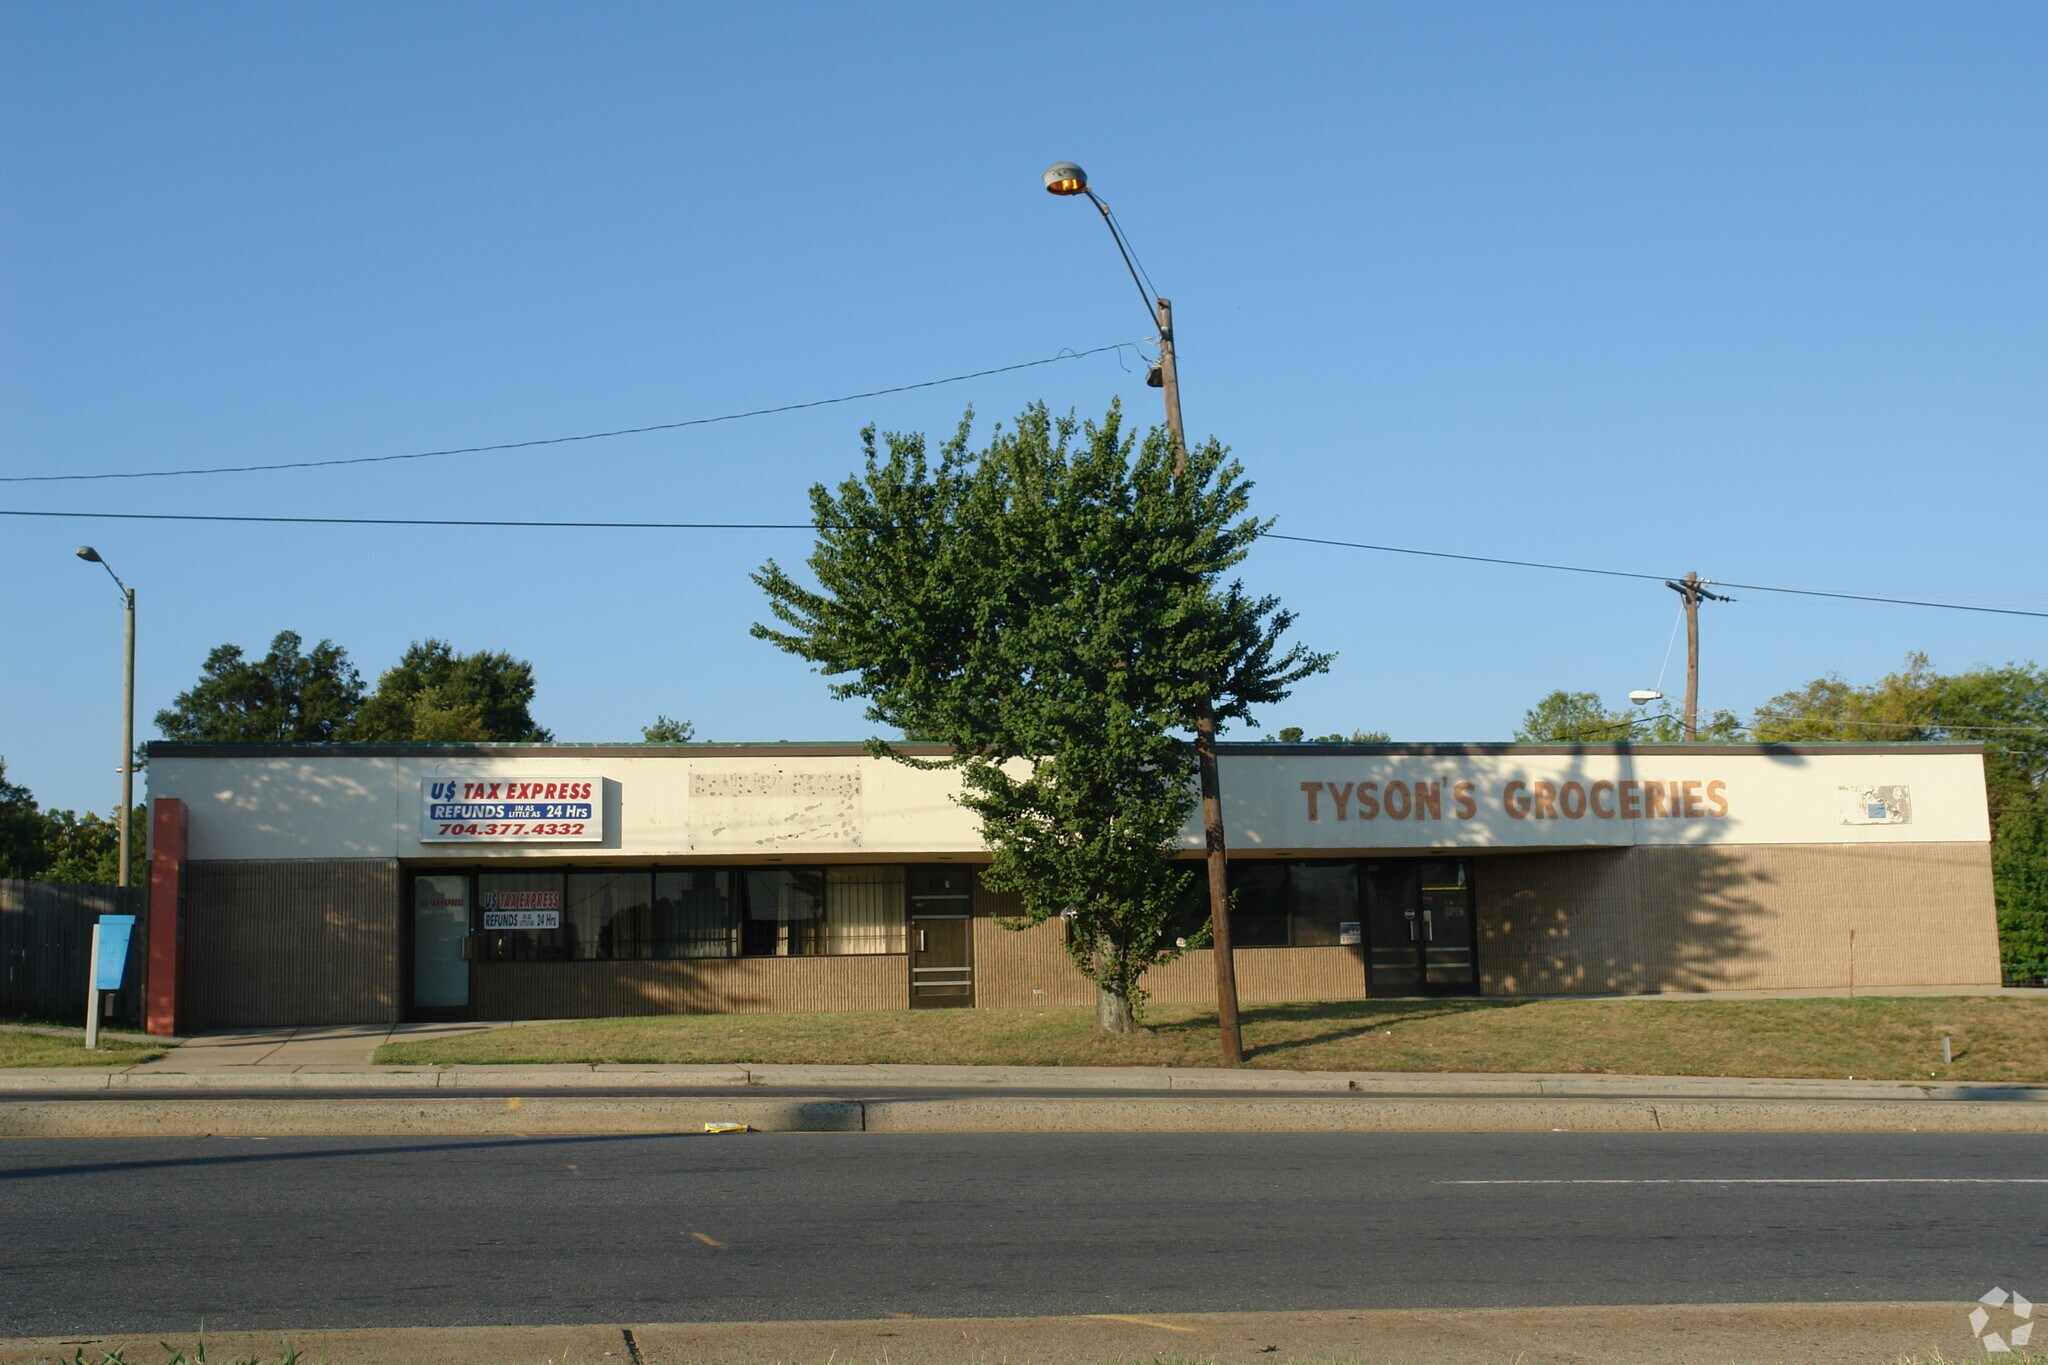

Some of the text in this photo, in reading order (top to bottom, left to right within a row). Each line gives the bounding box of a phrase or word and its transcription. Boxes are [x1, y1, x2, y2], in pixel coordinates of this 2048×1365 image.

[430, 780, 592, 802] U$ TAX EXPRESS
[1300, 776, 1729, 821] TYSON'S GROCERIES
[434, 805, 505, 819] REFUNDS
[546, 805, 588, 818] 24 Hrs
[438, 823, 586, 836] 704.377.4332
[499, 891, 519, 909] TAX
[517, 891, 560, 909] EXPRESS
[485, 914, 519, 927] REFUNDS
[536, 913, 557, 927] 24 Hrs
